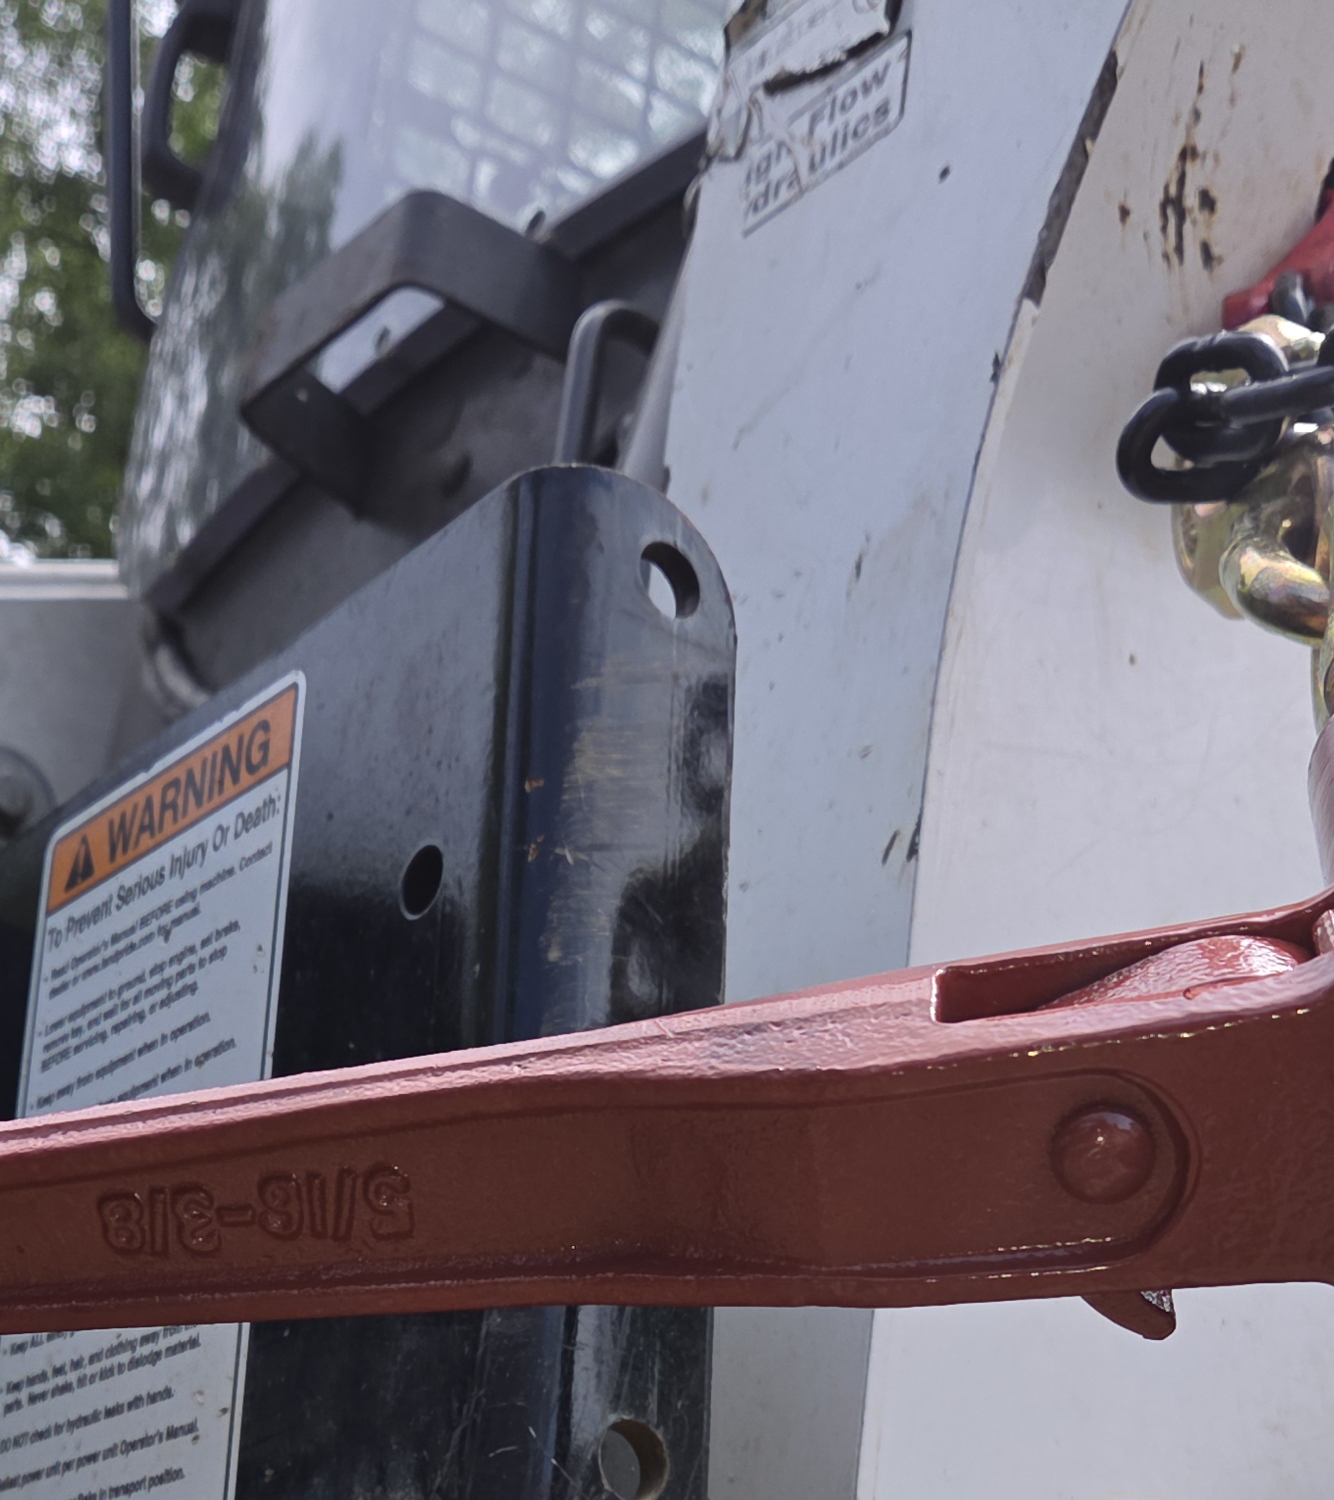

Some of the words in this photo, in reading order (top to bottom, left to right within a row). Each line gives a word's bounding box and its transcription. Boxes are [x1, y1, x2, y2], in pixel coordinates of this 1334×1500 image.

[807, 60, 891, 143] Flow
[108, 719, 270, 864] WARNING
[47, 927, 62, 951] To
[65, 893, 113, 939] Prevent
[114, 865, 165, 911] Serious
[168, 840, 208, 880] Injury
[212, 823, 229, 852] Or
[233, 793, 282, 840] Death:
[110, 920, 138, 946] Manual
[138, 899, 173, 930] BEFORE
[174, 888, 197, 908] using
[199, 866, 235, 894] machine.
[238, 841, 272, 871] Contact
[42, 1032, 69, 1053] remove
[86, 1012, 102, 1030] and
[143, 975, 173, 999] moving
[174, 962, 196, 984] parts
[208, 945, 227, 964] stop
[44, 1015, 67, 1036] Lower
[67, 992, 107, 1023] equipment
[116, 970, 146, 1000] ground,
[148, 960, 167, 978] stop
[36, 1093, 55, 1108] Keep
[55, 1083, 74, 1099] away
[76, 1072, 94, 1089] from
[94, 1048, 136, 1079] equipment
[137, 1039, 158, 1057] when
[169, 1012, 210, 1041] operation.
[40, 1045, 71, 1073] BEFORE
[160, 1064, 182, 1083] when
[193, 1037, 235, 1068] operation.
[27, 1389, 48, 1405] Never
[126, 1349, 162, 1371] dislodge
[164, 1333, 201, 1358] material.
[87, 1348, 103, 1365] and
[104, 1337, 138, 1359] clothing
[138, 1330, 160, 1347] away
[0, 1437, 12, 1454] DO
[11, 1431, 29, 1449] NOT
[29, 1425, 51, 1444] check
[65, 1408, 102, 1434] hydraulic
[103, 1402, 124, 1419] leaks
[126, 1394, 144, 1412] with
[44, 1460, 61, 1478] unit
[75, 1450, 101, 1470] power
[101, 1442, 118, 1461] unit
[119, 1430, 163, 1456] Operator's
[165, 1418, 198, 1441] Manual.
[108, 1476, 146, 1499] transport
[147, 1467, 184, 1491] position.
